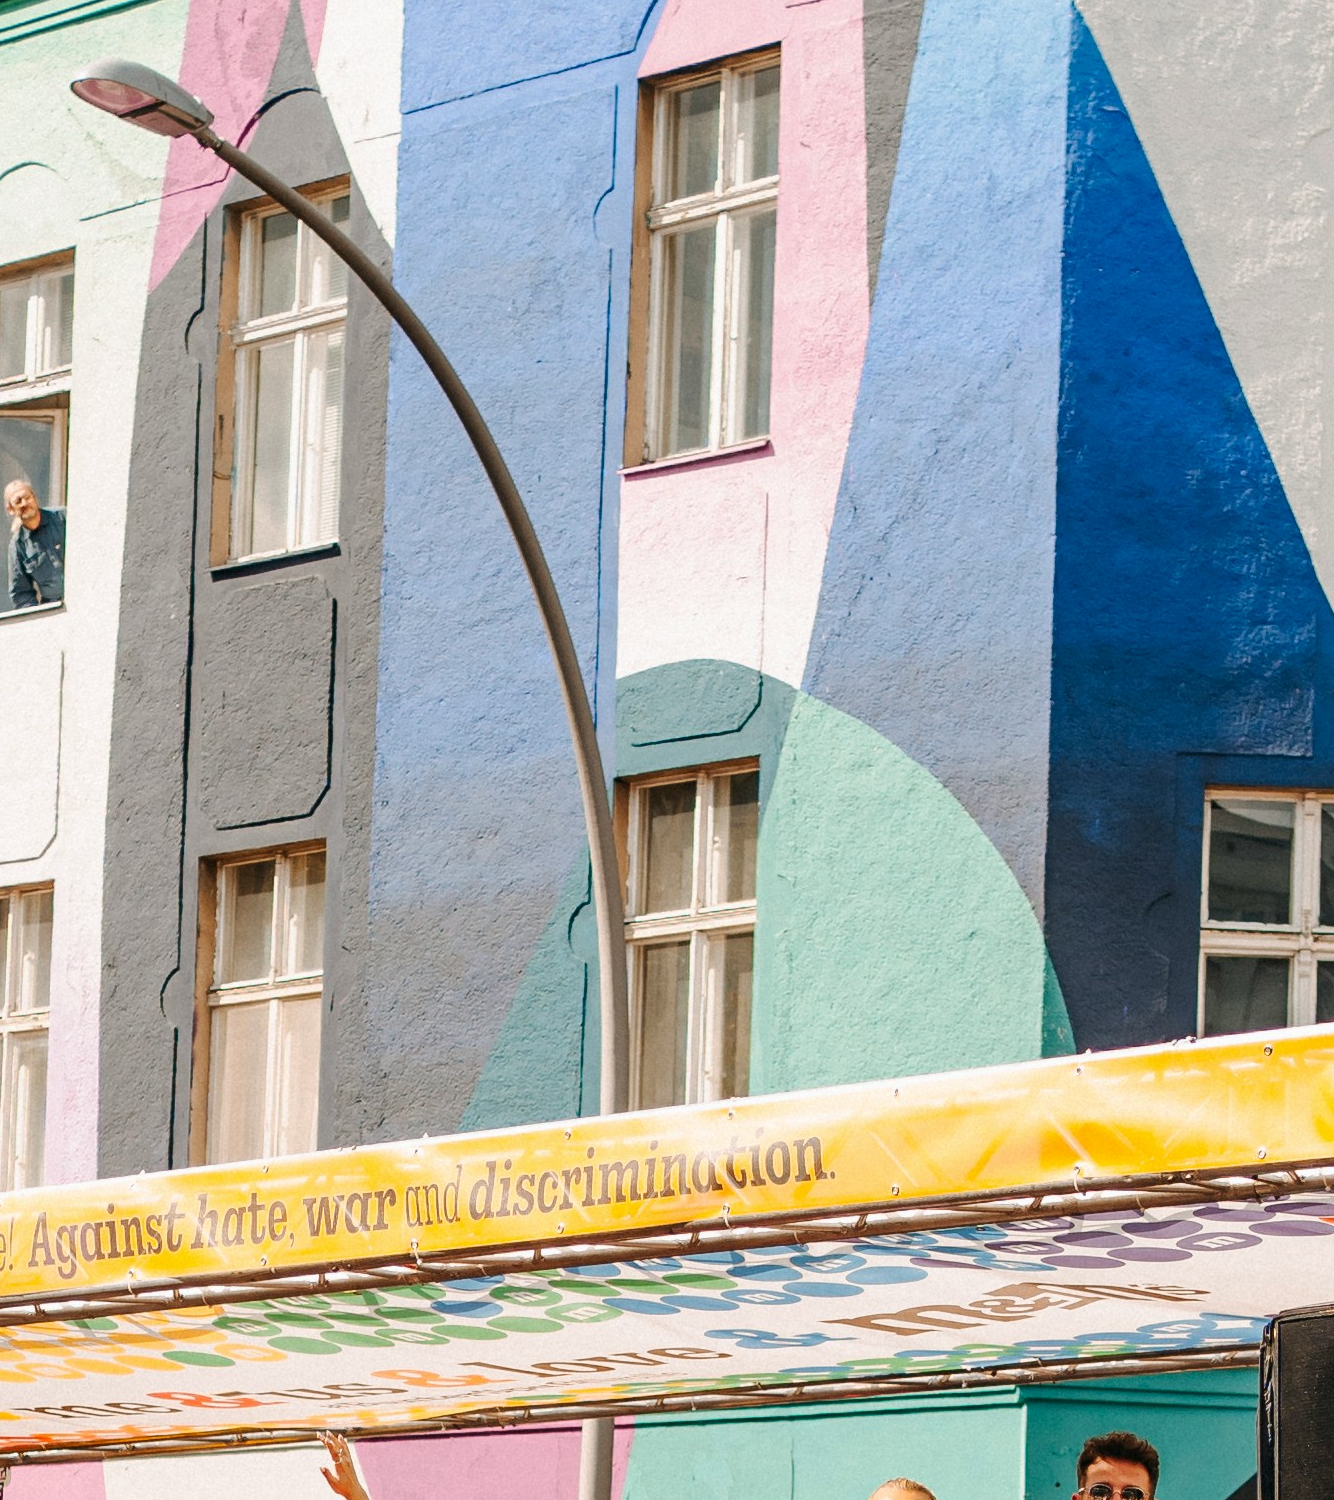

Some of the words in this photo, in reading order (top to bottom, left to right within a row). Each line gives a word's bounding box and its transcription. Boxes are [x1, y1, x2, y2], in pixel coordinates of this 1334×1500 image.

[28, 1202, 185, 1280] Against
[190, 1192, 295, 1249] hate,
[303, 1188, 396, 1238] war
[405, 1164, 463, 1228] and
[468, 1126, 836, 1220] discrimination.
[459, 1347, 732, 1377] love
